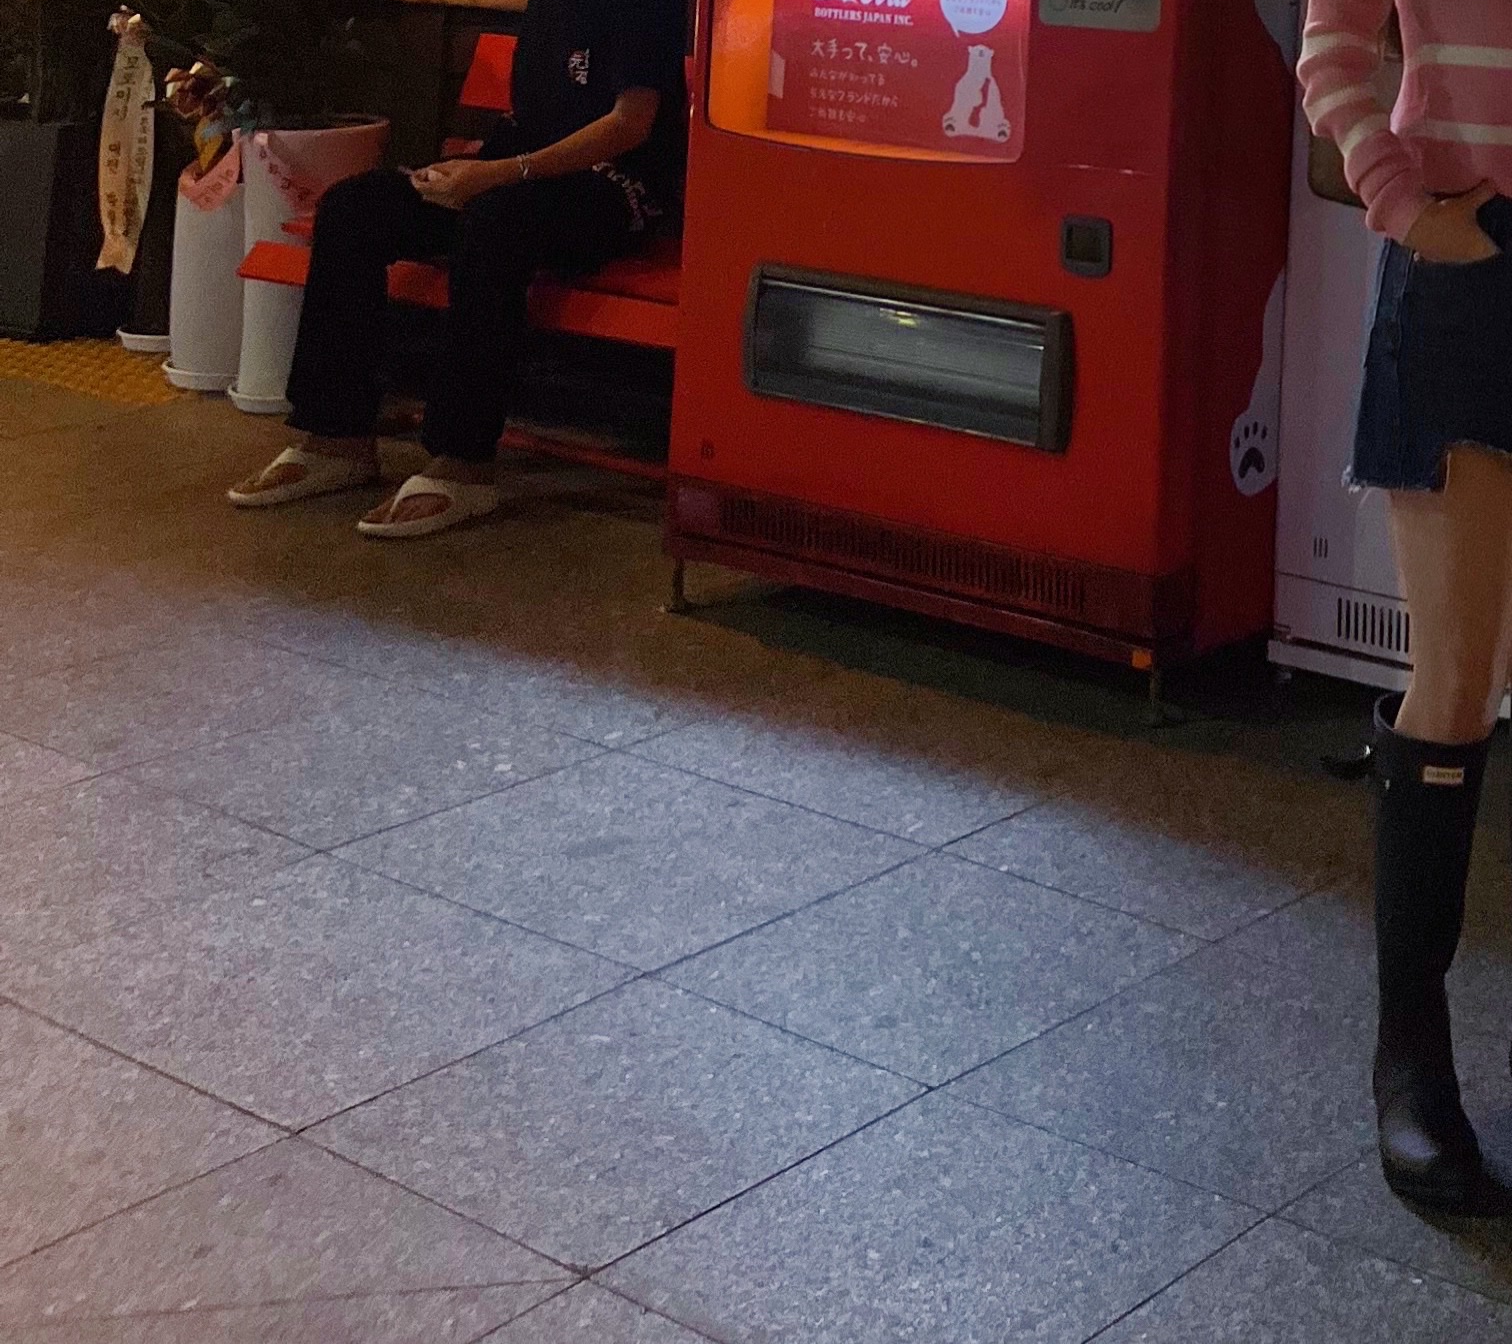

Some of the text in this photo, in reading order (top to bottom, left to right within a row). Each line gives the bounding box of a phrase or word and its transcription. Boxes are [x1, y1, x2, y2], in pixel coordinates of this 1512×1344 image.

[814, 7, 914, 26] BOTTLERS JAPAN INC.
